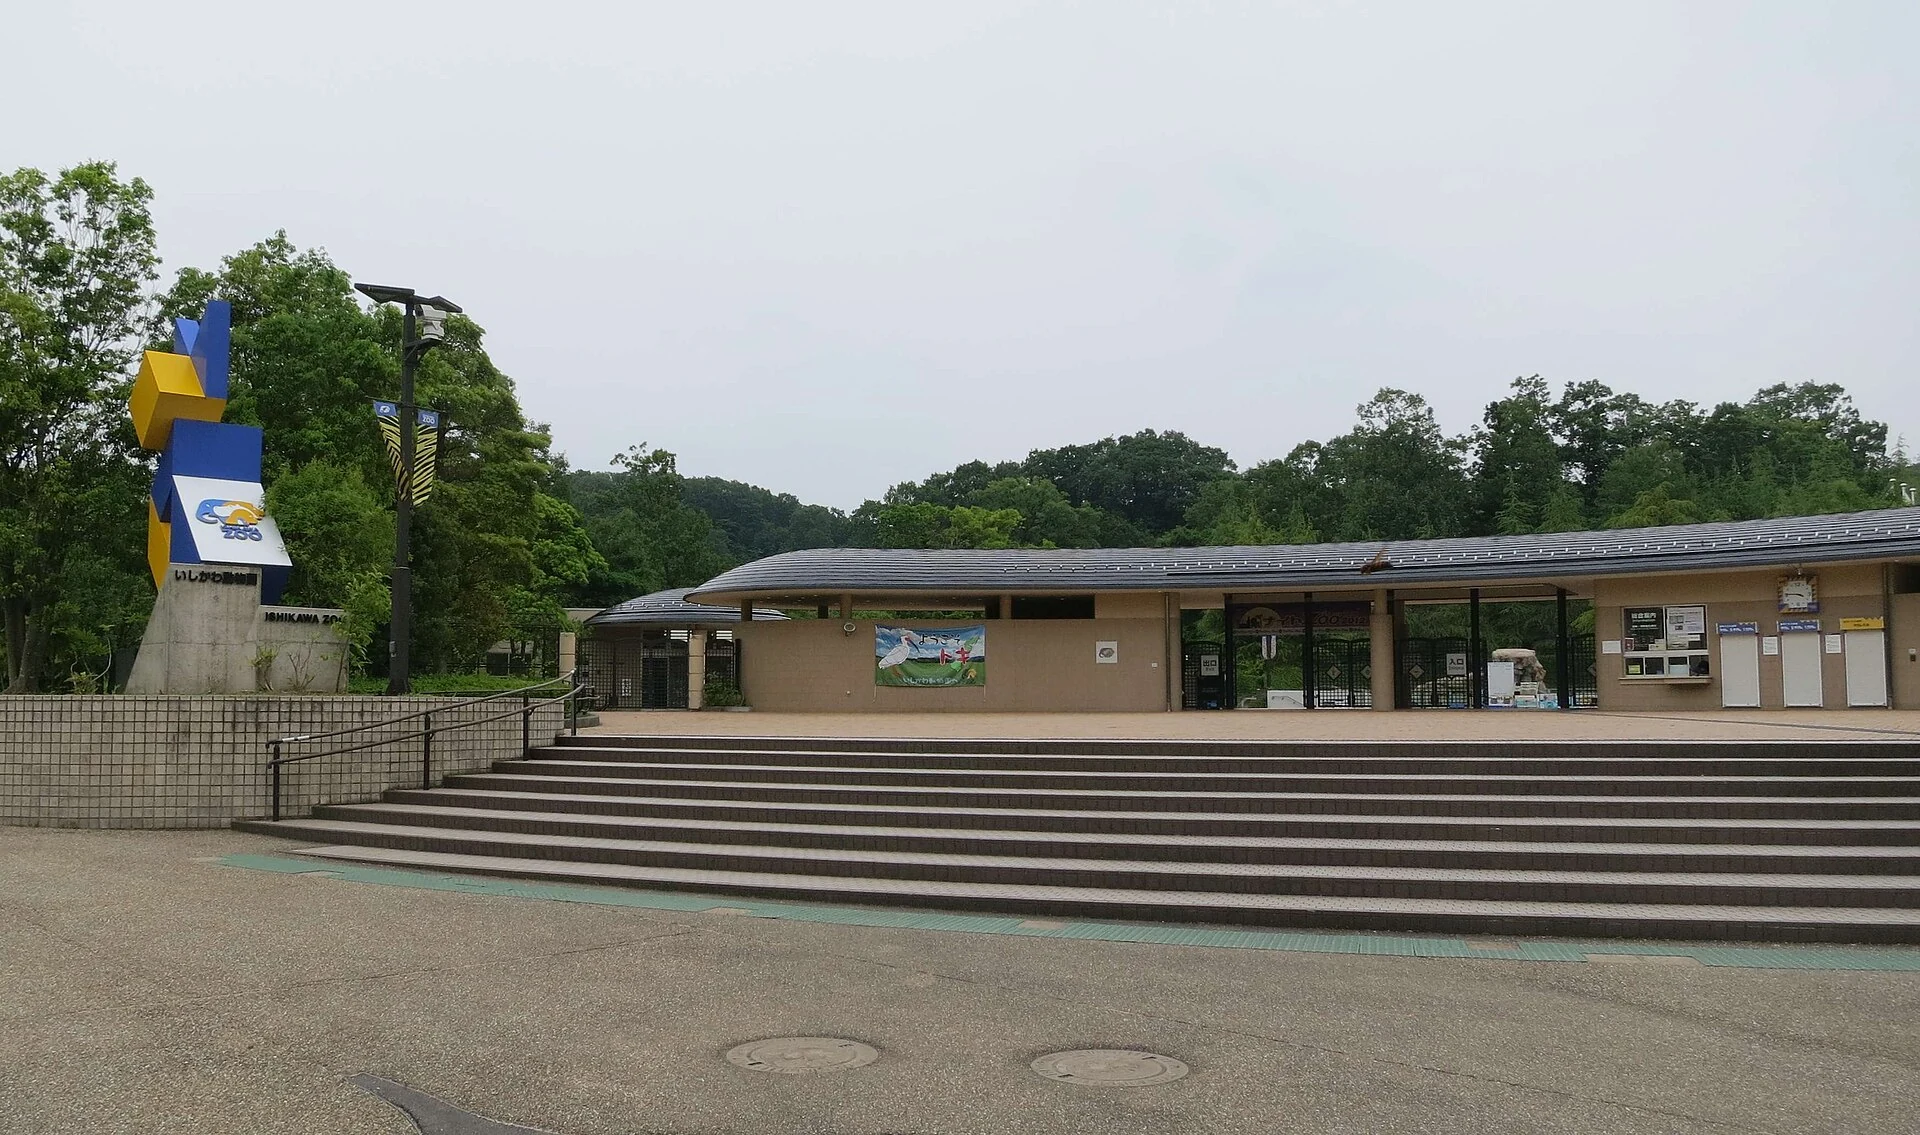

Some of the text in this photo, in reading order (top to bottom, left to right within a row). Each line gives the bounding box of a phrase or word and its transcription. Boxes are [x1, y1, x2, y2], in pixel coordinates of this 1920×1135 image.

[223, 529, 263, 542] ZOO
[264, 611, 342, 625] ISHIKAWA ZO
[918, 633, 961, 646] ようこそ
[939, 646, 970, 666] トキ
[1449, 658, 1464, 666] 入口
